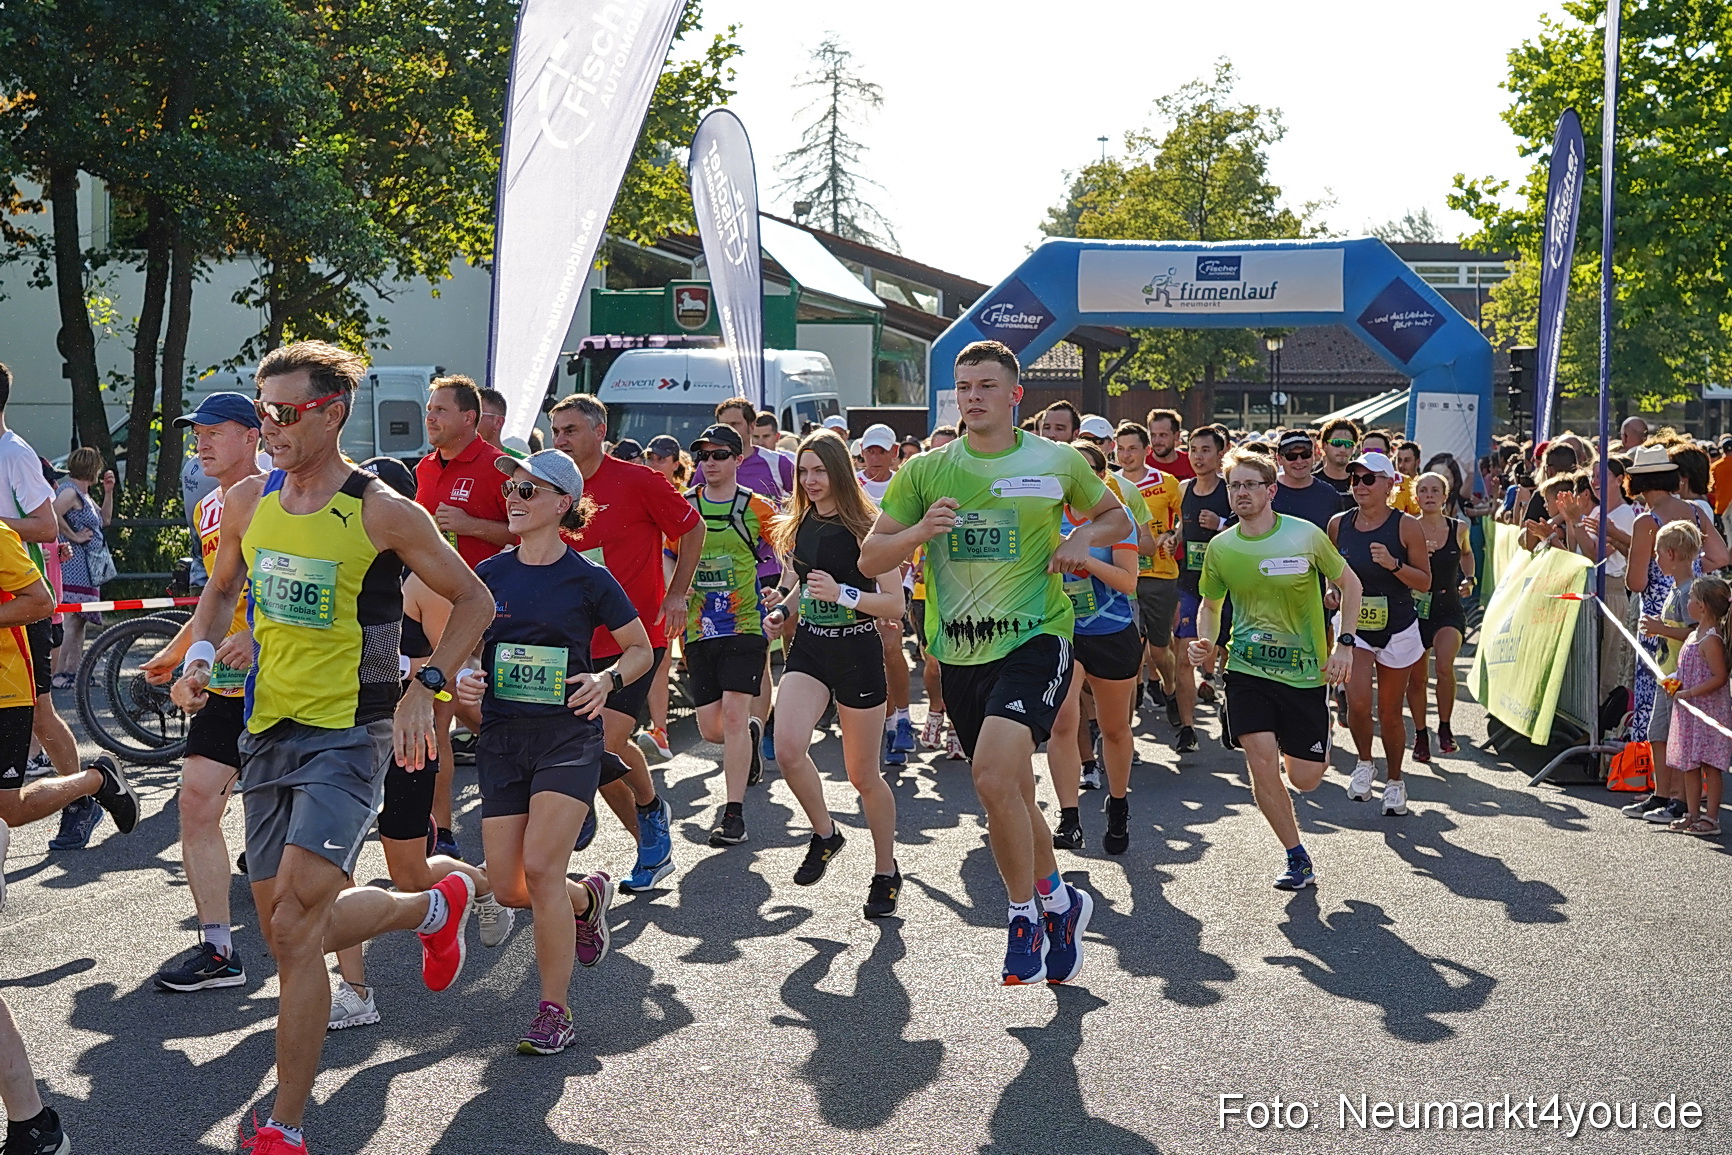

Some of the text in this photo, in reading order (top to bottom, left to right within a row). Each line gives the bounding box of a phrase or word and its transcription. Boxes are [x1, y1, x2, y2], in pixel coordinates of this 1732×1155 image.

[562, 0, 628, 118] Fisch
[1555, 138, 1576, 249] Fischer
[1205, 264, 1239, 273] Fischer
[1181, 281, 1279, 300] firmenlauf
[990, 312, 1044, 324] Fischer
[995, 322, 1039, 330] AUTOMOBILE
[611, 379, 656, 389] abavent
[951, 527, 1017, 555] RUN 679 2022
[966, 547, 982, 555] Vogl
[698, 570, 722, 582] 601
[255, 574, 331, 620] RUN 1596 2022
[262, 597, 287, 611] Werner
[288, 603, 317, 616] Tobias
[810, 599, 839, 614] 199
[808, 622, 873, 637] NIKE PRO
[1260, 644, 1288, 659] 160
[1291, 649, 1299, 667] 2022
[509, 663, 547, 685] 494
[553, 670, 563, 697] 2022
[522, 683, 554, 692] Anna-Maria
[1005, 703, 1026, 714] adidas
